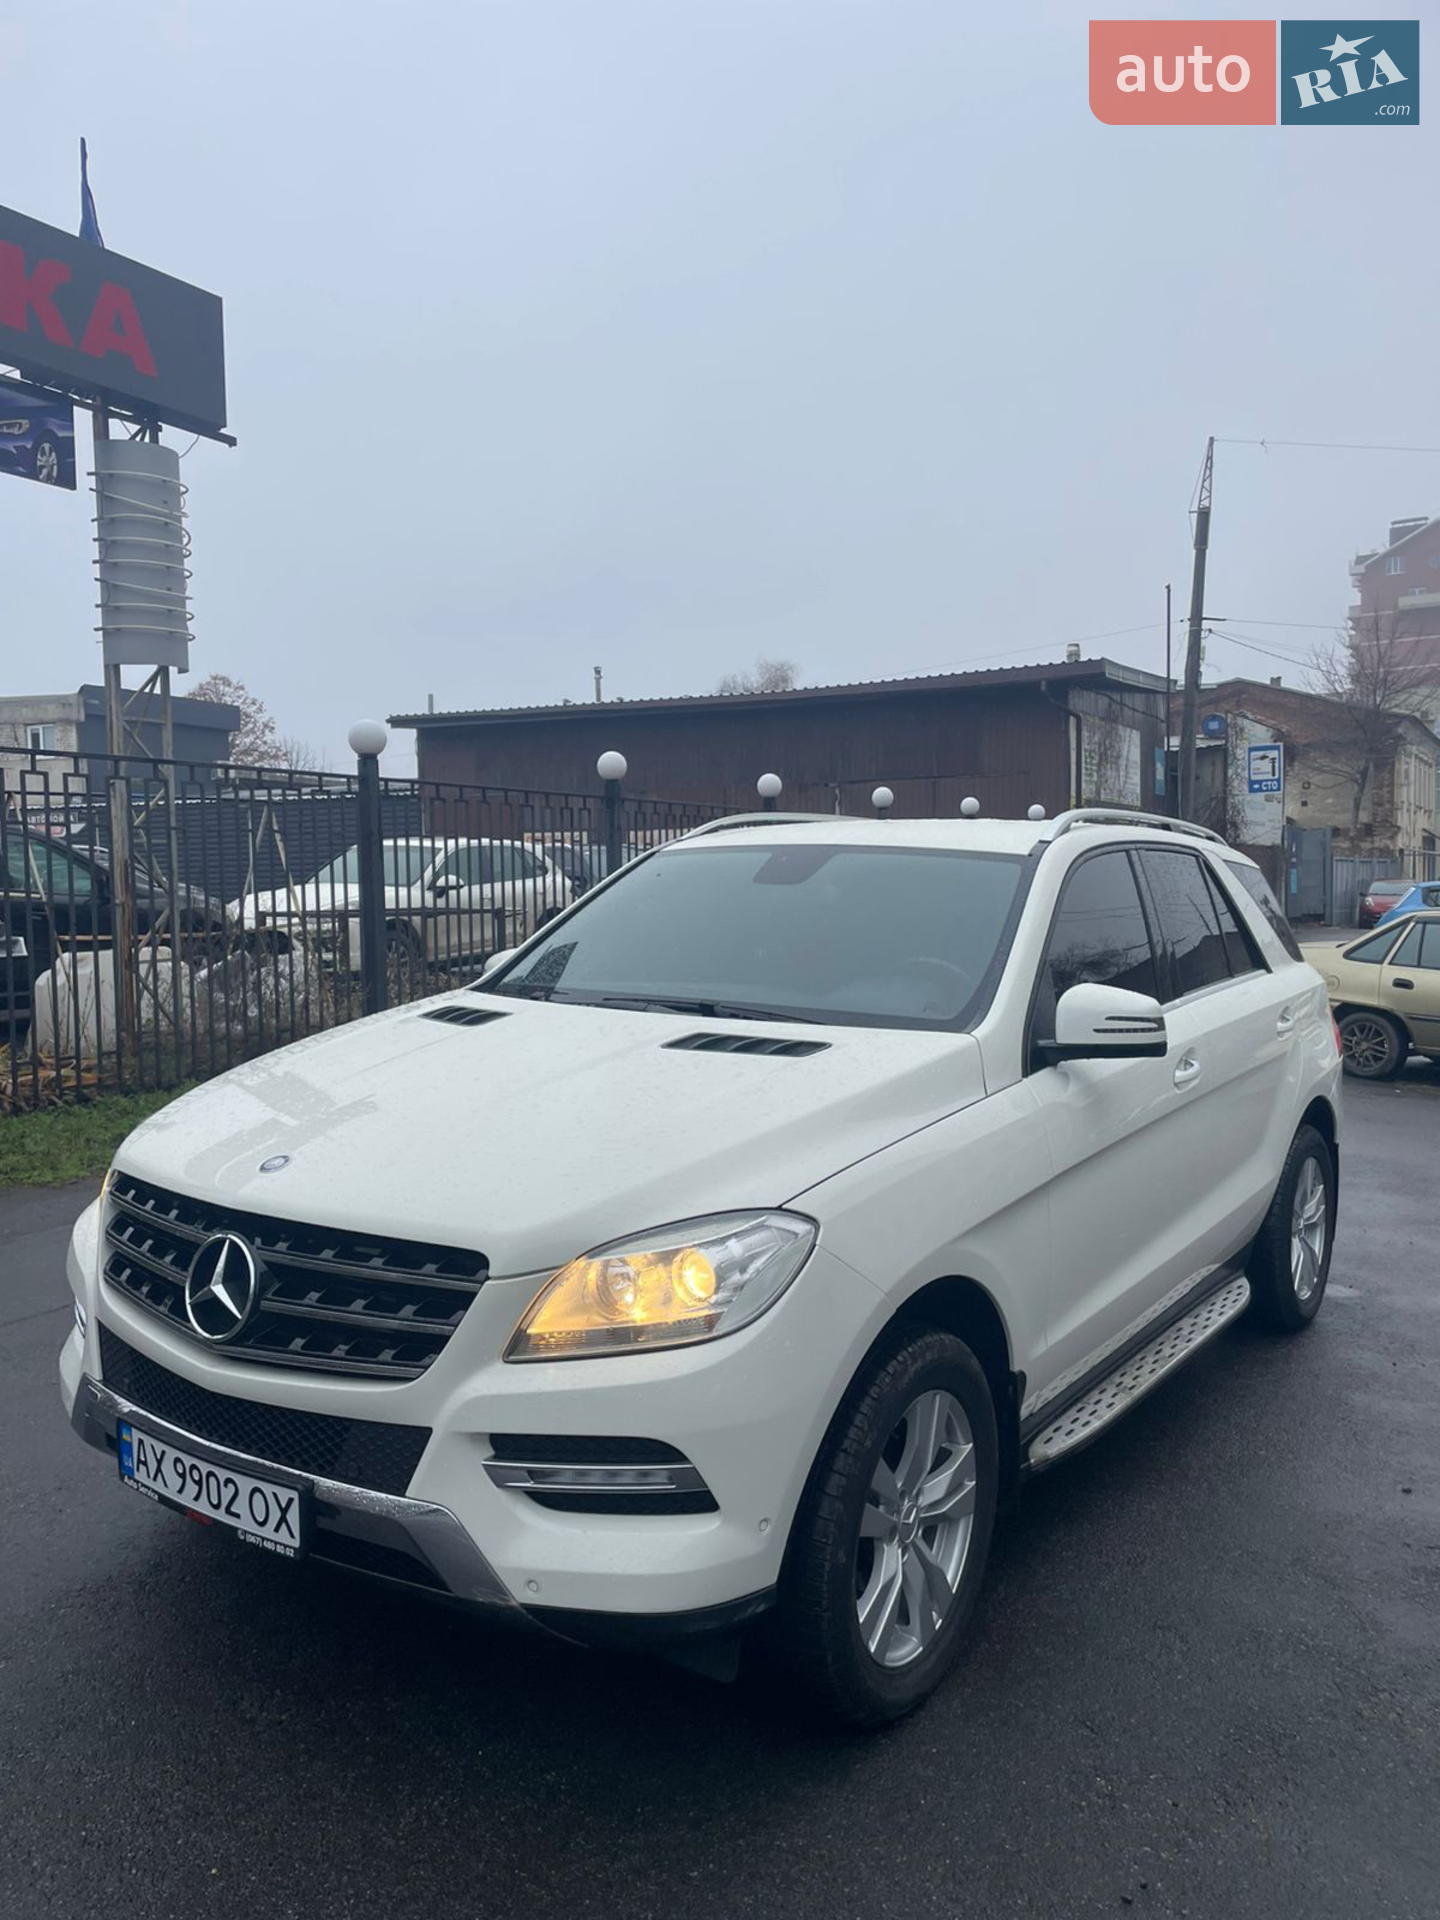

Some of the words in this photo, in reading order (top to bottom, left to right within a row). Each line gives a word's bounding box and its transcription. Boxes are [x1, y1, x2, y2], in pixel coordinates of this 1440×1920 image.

[1261, 781, 1278, 790] СТО
[123, 1454, 134, 1469] UA
[136, 1437, 169, 1488] AX
[173, 1456, 241, 1520] 9902
[248, 1486, 297, 1540] OX
